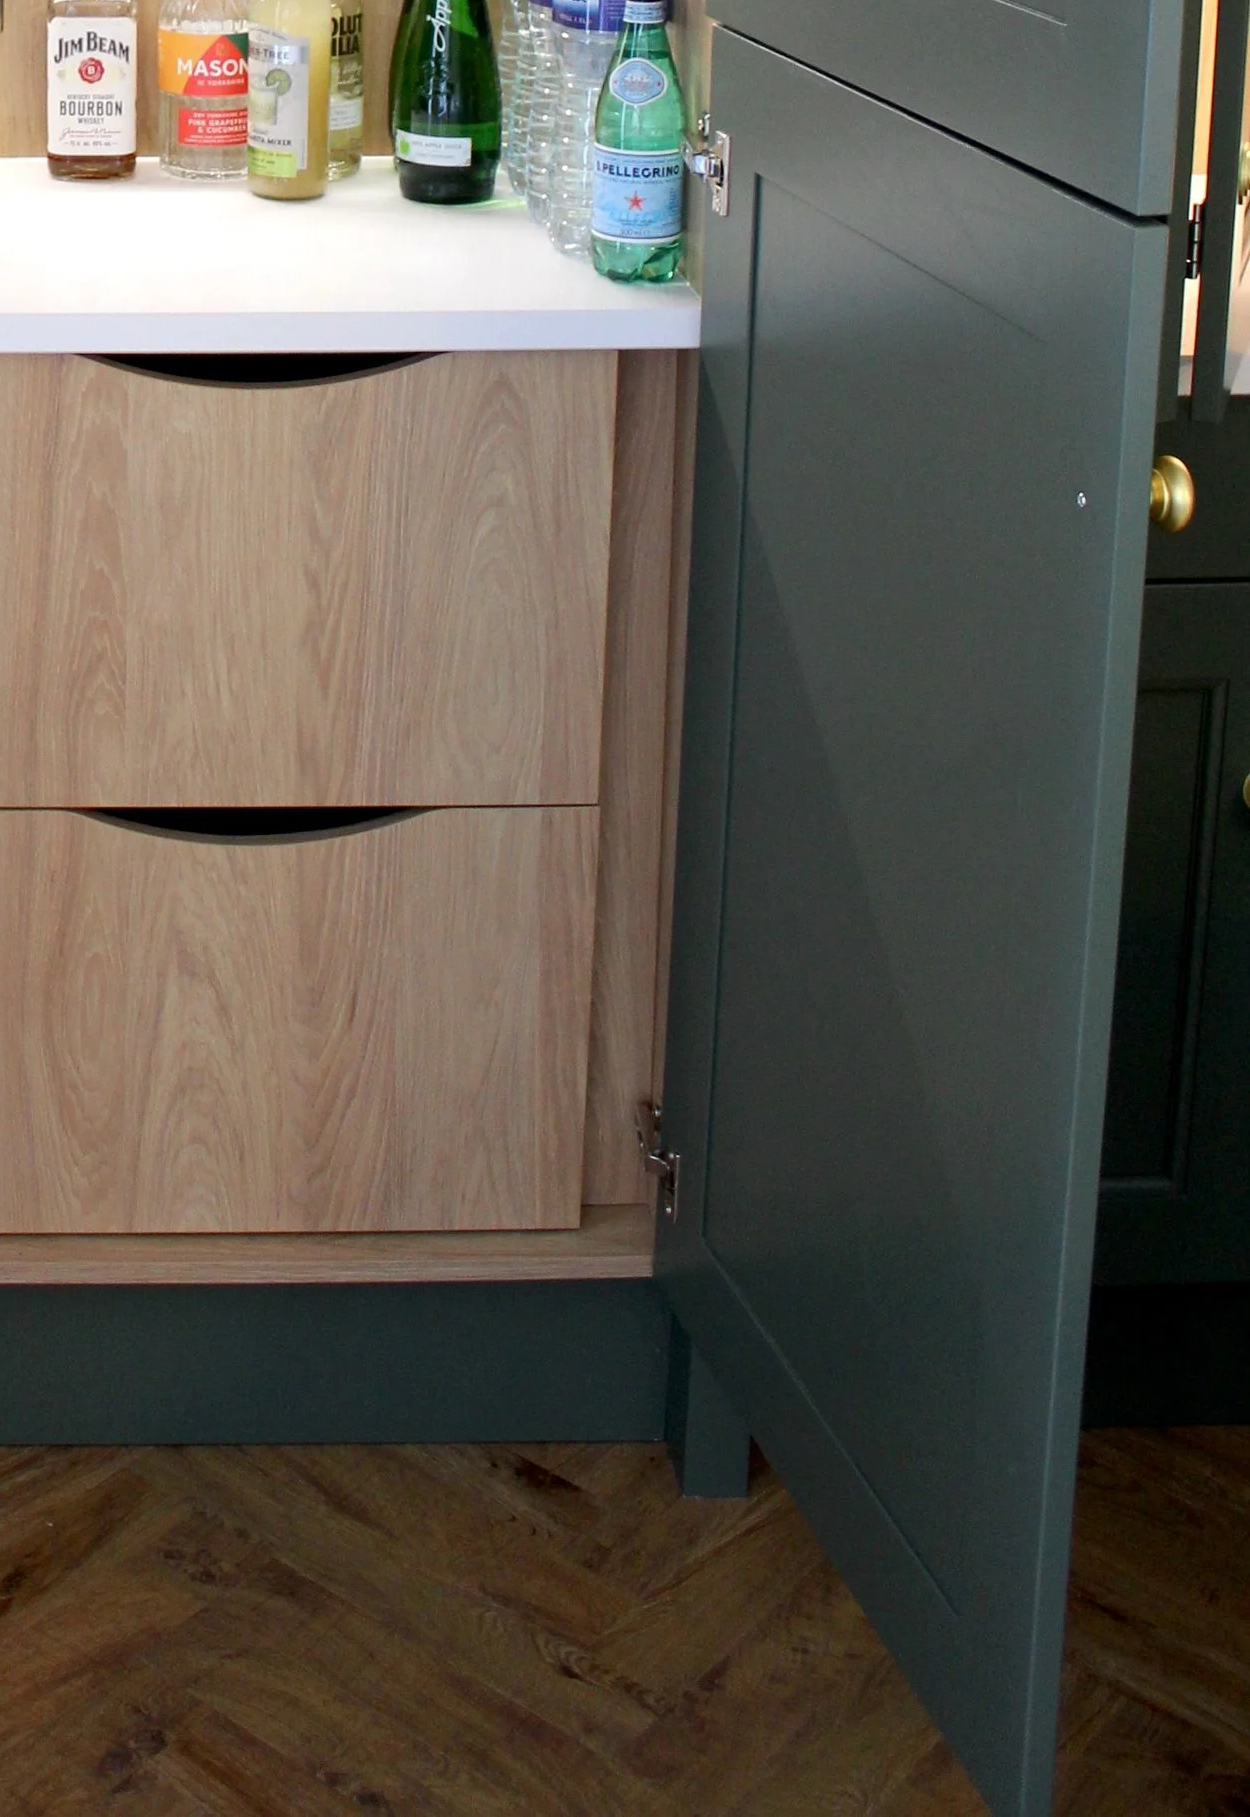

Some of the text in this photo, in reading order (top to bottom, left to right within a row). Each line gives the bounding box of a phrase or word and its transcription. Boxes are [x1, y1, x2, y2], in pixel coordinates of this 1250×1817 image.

[54, 37, 83, 64] JIM
[86, 31, 130, 64] BEAM
[59, 100, 123, 116] BOURBON
[188, 118, 206, 126] PINK
